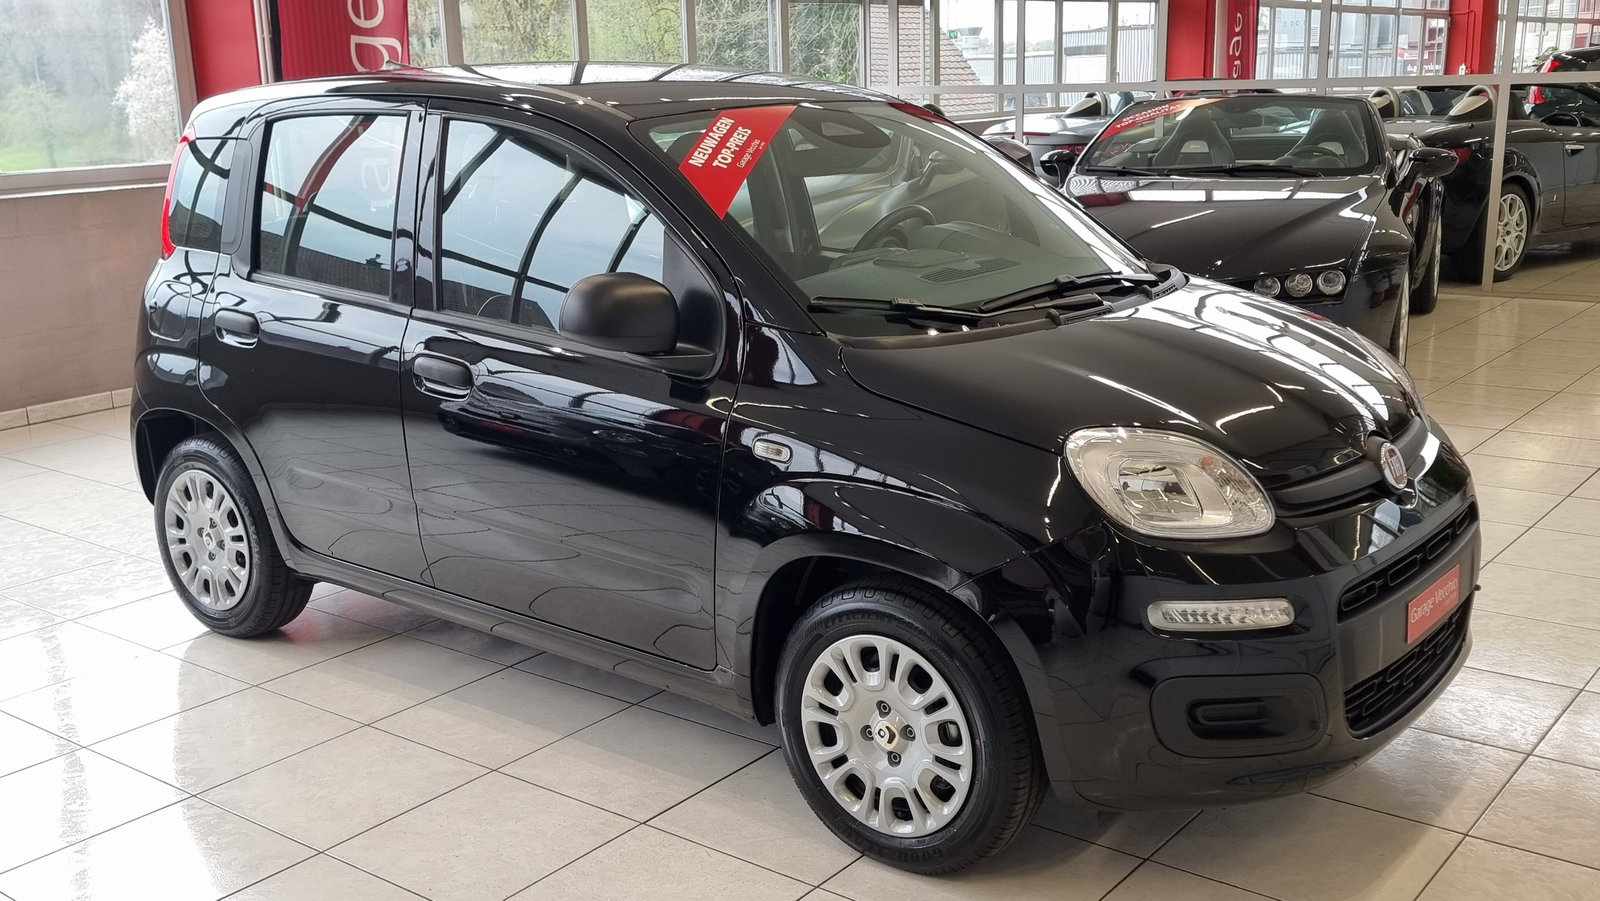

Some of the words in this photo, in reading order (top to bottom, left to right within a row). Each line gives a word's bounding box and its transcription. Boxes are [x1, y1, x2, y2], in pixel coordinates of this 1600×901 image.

[1122, 104, 1170, 122] OCCASION
[688, 116, 736, 168] NEUWAGEN
[712, 126, 752, 169] TOP-PREIS
[736, 150, 753, 168] Garage
[1410, 597, 1435, 624] Garage
[1435, 577, 1458, 604] Vecchio
